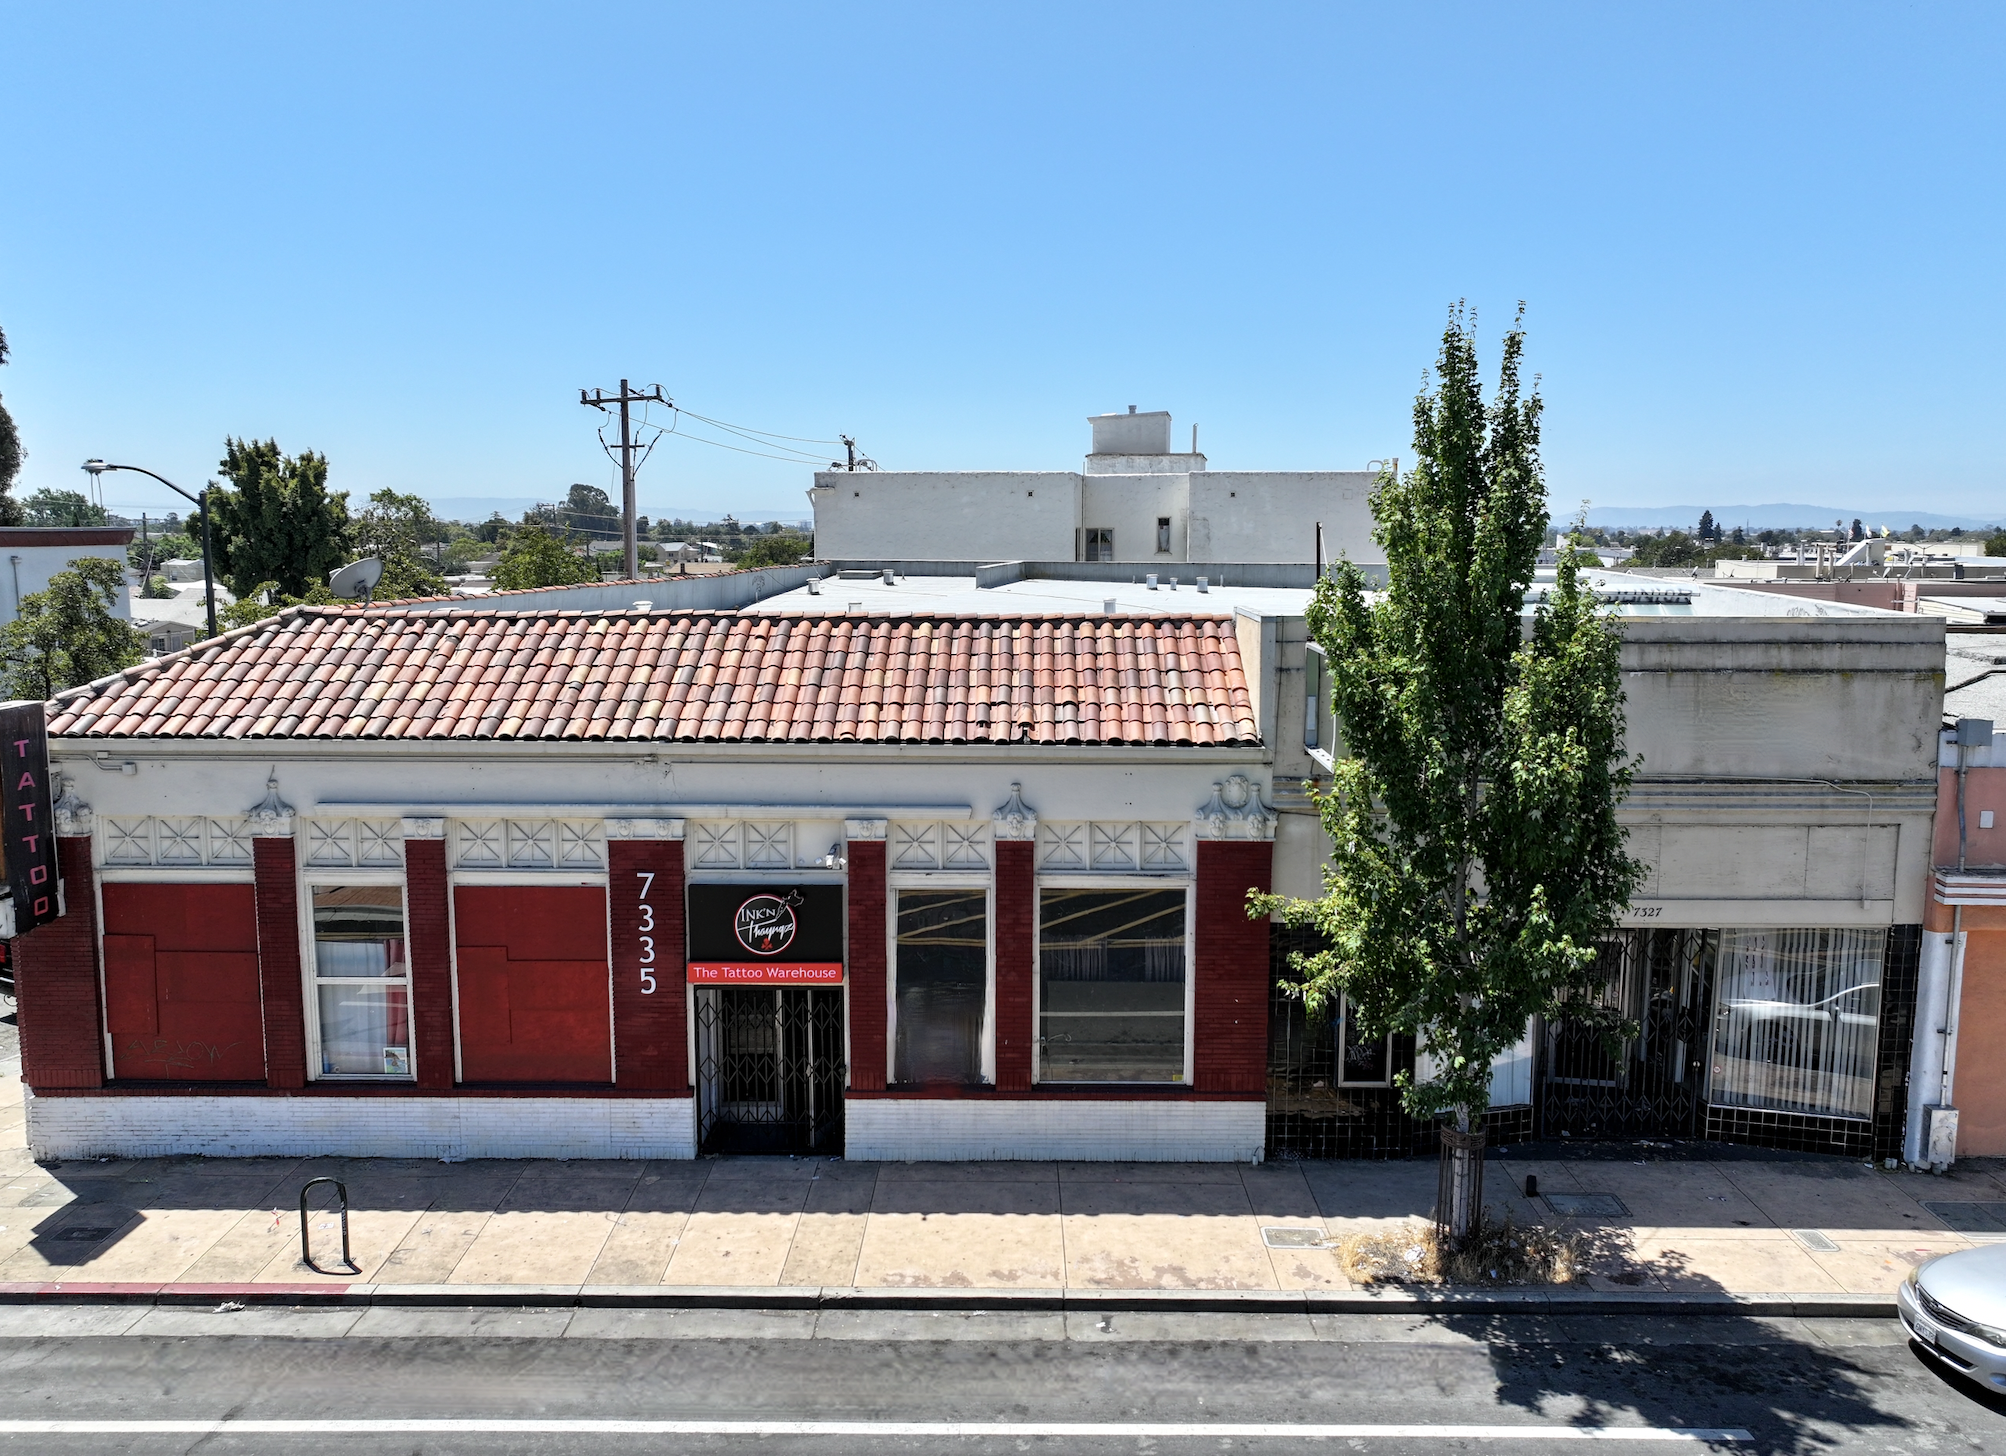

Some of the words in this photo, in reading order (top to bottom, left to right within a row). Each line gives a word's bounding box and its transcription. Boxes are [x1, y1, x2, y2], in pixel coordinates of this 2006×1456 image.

[13, 739, 49, 917] TATTOO
[636, 872, 657, 995] 7335
[1633, 907, 1663, 918] 7327
[693, 966, 718, 979] The
[721, 966, 763, 979] Tattoo
[766, 966, 837, 979] Warehouse
